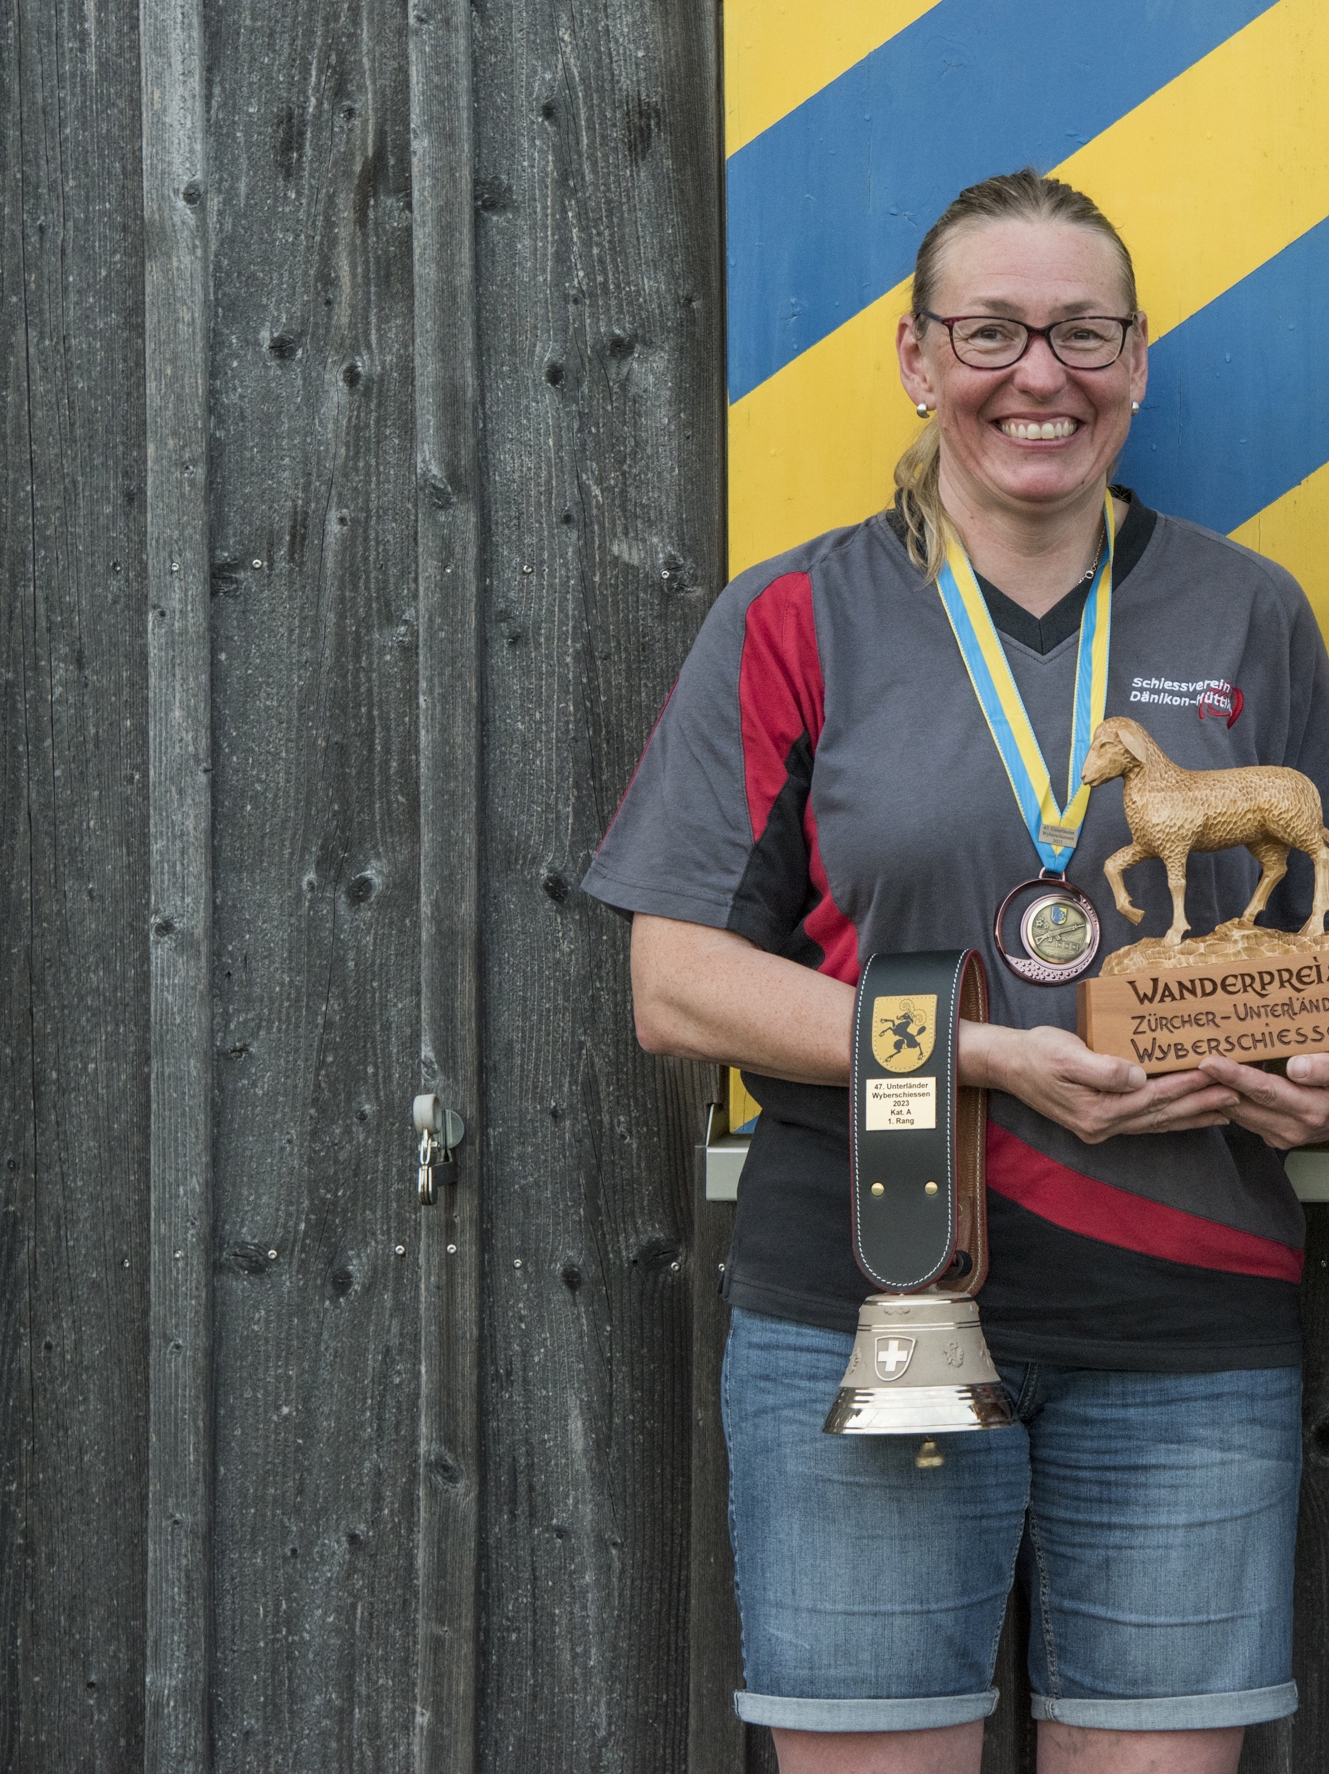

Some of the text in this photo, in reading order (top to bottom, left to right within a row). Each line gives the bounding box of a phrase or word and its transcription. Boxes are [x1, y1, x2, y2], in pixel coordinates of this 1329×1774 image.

[1132, 678, 1231, 692] Schiessverein
[886, 1082, 929, 1090] Unterländer
[871, 1091, 931, 1100] Wyberschiessen
[895, 1117, 915, 1126] Rang
